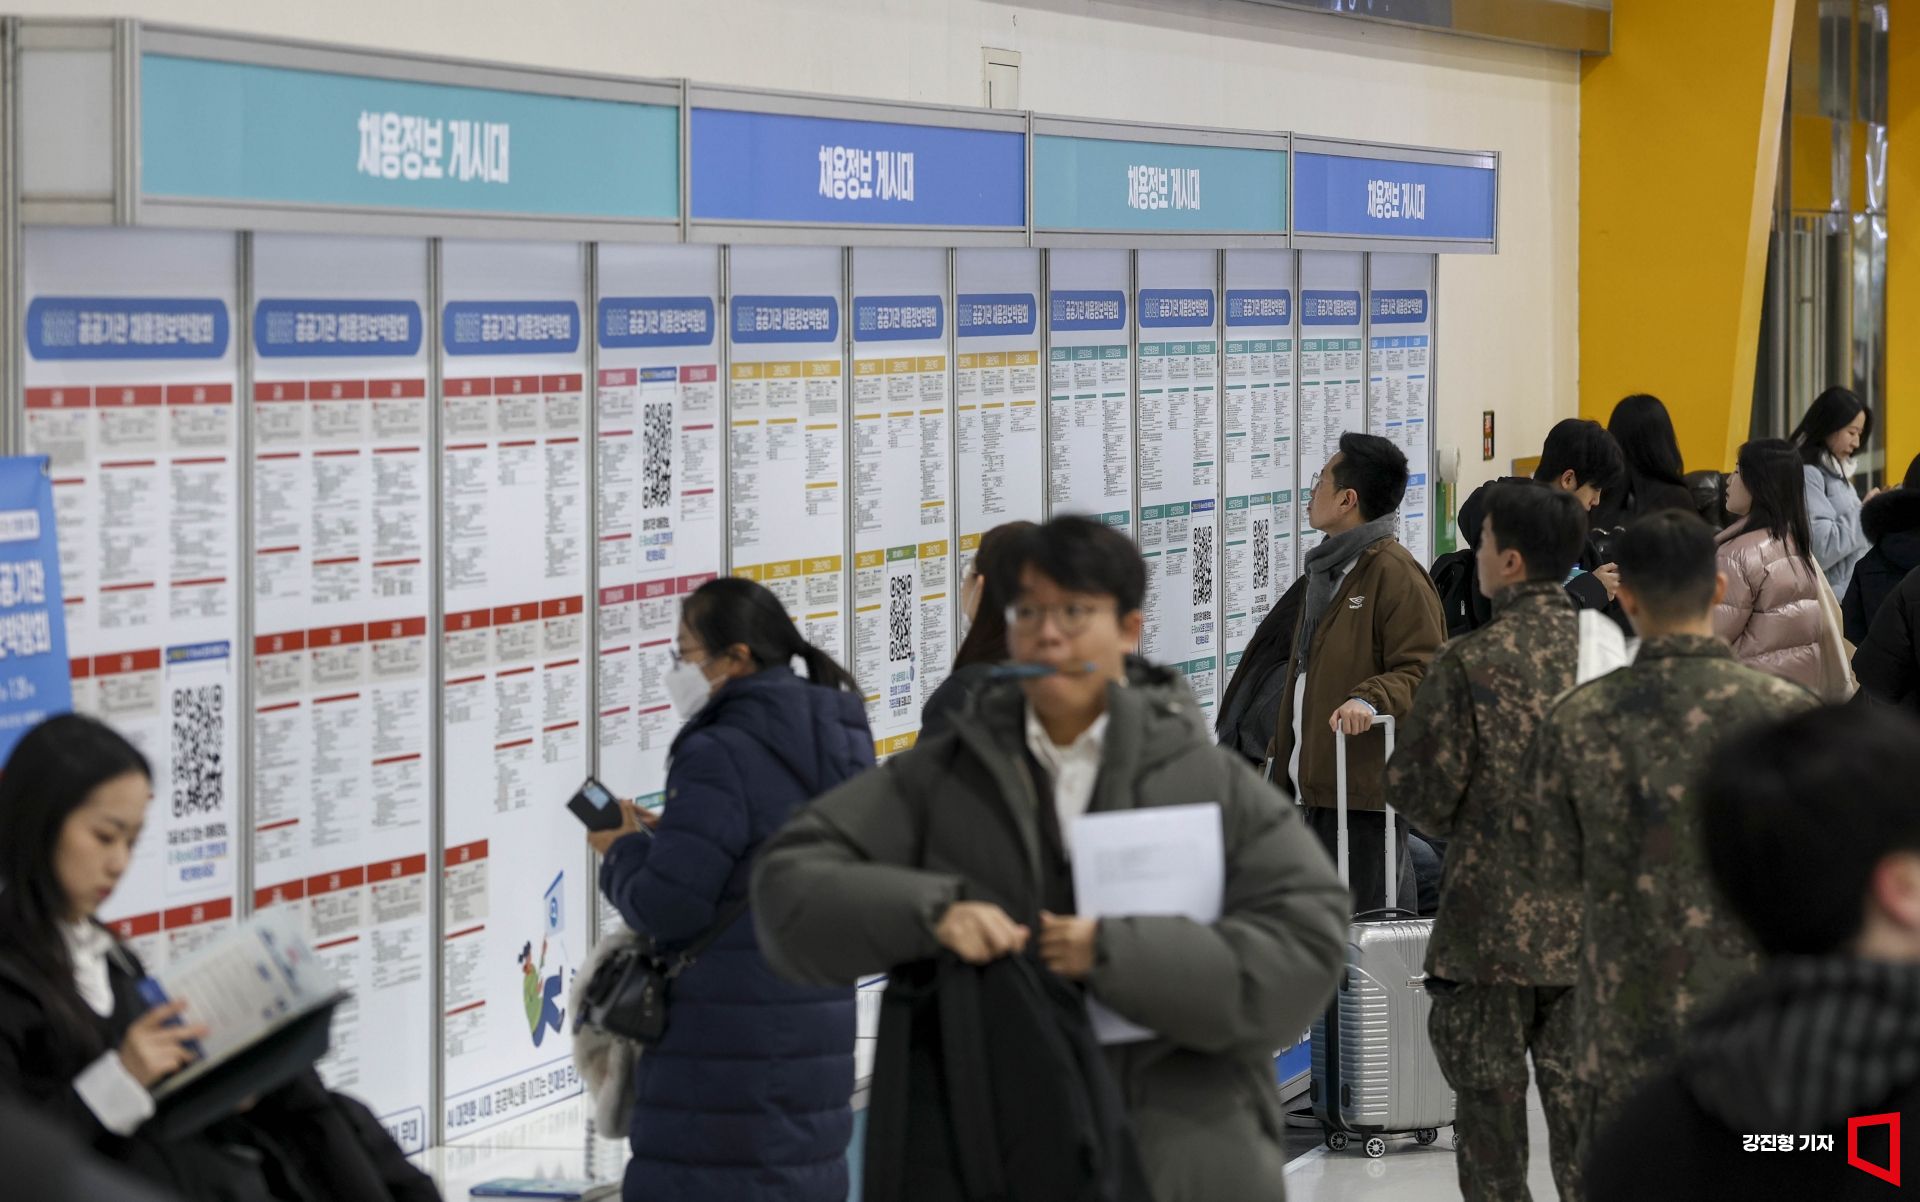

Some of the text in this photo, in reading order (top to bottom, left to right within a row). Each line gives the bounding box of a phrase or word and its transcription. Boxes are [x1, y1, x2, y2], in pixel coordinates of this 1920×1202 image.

[357, 110, 510, 184] 채용정보 게시대
[818, 145, 915, 203] 채용정보 게시대
[1127, 163, 1201, 212] 채용정보 게시대
[1367, 178, 1426, 221] 채용정보 게시대
[877, 306, 901, 329] 공공기관
[901, 306, 937, 328] 채용정보박람회
[972, 304, 993, 325] 공공기관
[993, 304, 1029, 324] 채용정보박람회
[1066, 300, 1085, 320] 공공기관
[1085, 300, 1119, 320] 채용정보박람회
[1160, 298, 1179, 318] 공공기관
[1179, 298, 1209, 317] 채용정보박람회
[1243, 298, 1261, 317] 공공기관
[1261, 298, 1287, 316] 채용정보박람회
[1317, 299, 1334, 316] 공공기관
[1333, 299, 1357, 316] 채용정보박람회
[1380, 298, 1397, 315] 공공기관
[1396, 298, 1423, 315] 채용정보박람회
[629, 309, 659, 335] 공공기관
[659, 309, 707, 333] 채용정보박람회
[756, 307, 782, 331] 공공기관
[782, 307, 830, 331] 채용정보박람회
